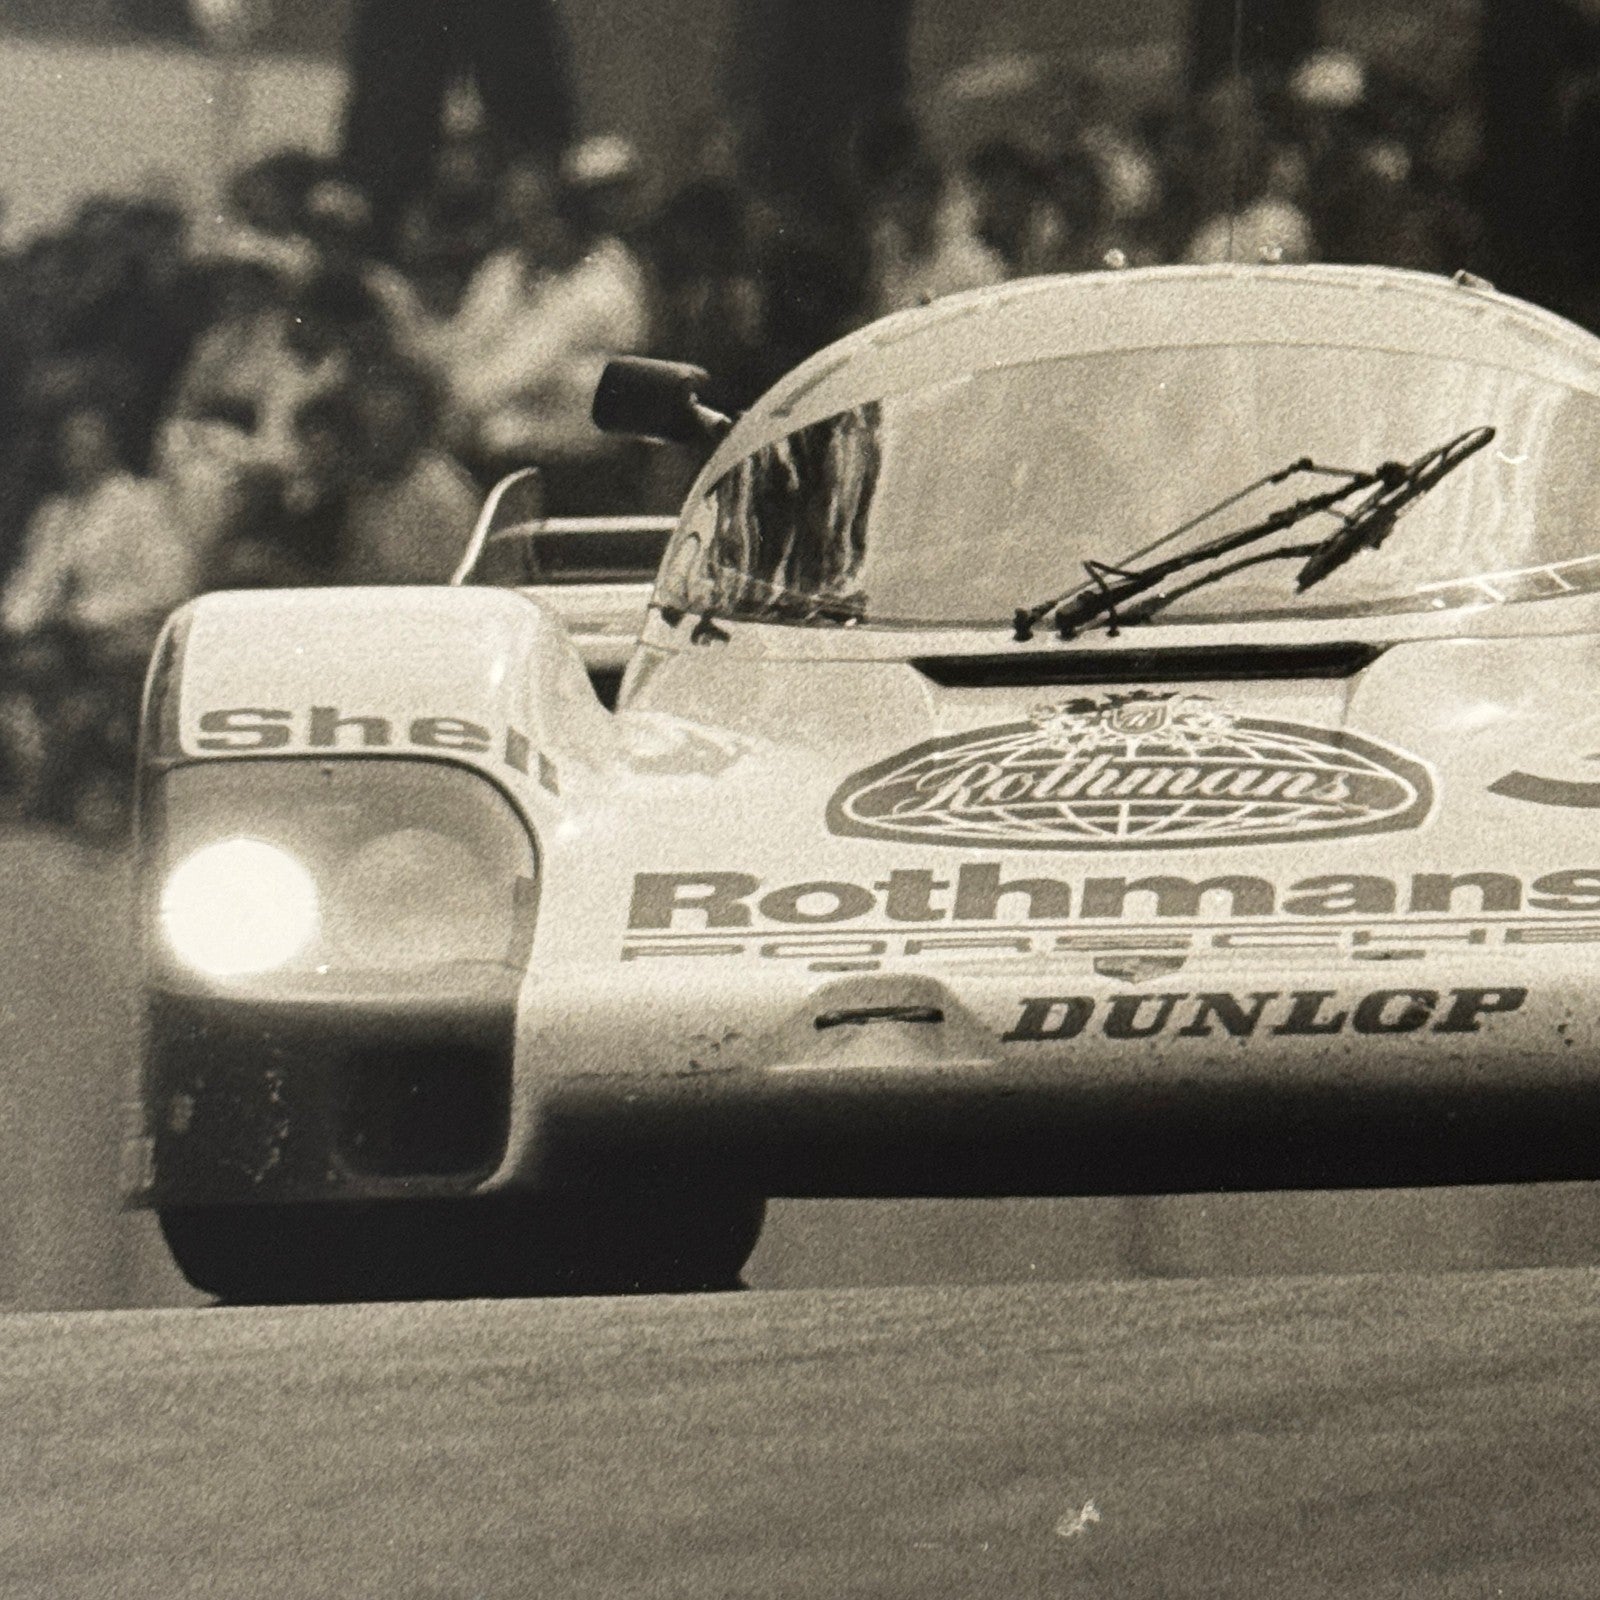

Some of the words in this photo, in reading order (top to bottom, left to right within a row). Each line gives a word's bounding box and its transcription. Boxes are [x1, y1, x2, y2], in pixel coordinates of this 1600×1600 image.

[198, 705, 560, 796] Shell
[892, 753, 1354, 816] Rothmans
[626, 862, 1600, 929] Rothmans
[1002, 986, 1529, 1042] DUNLOP
